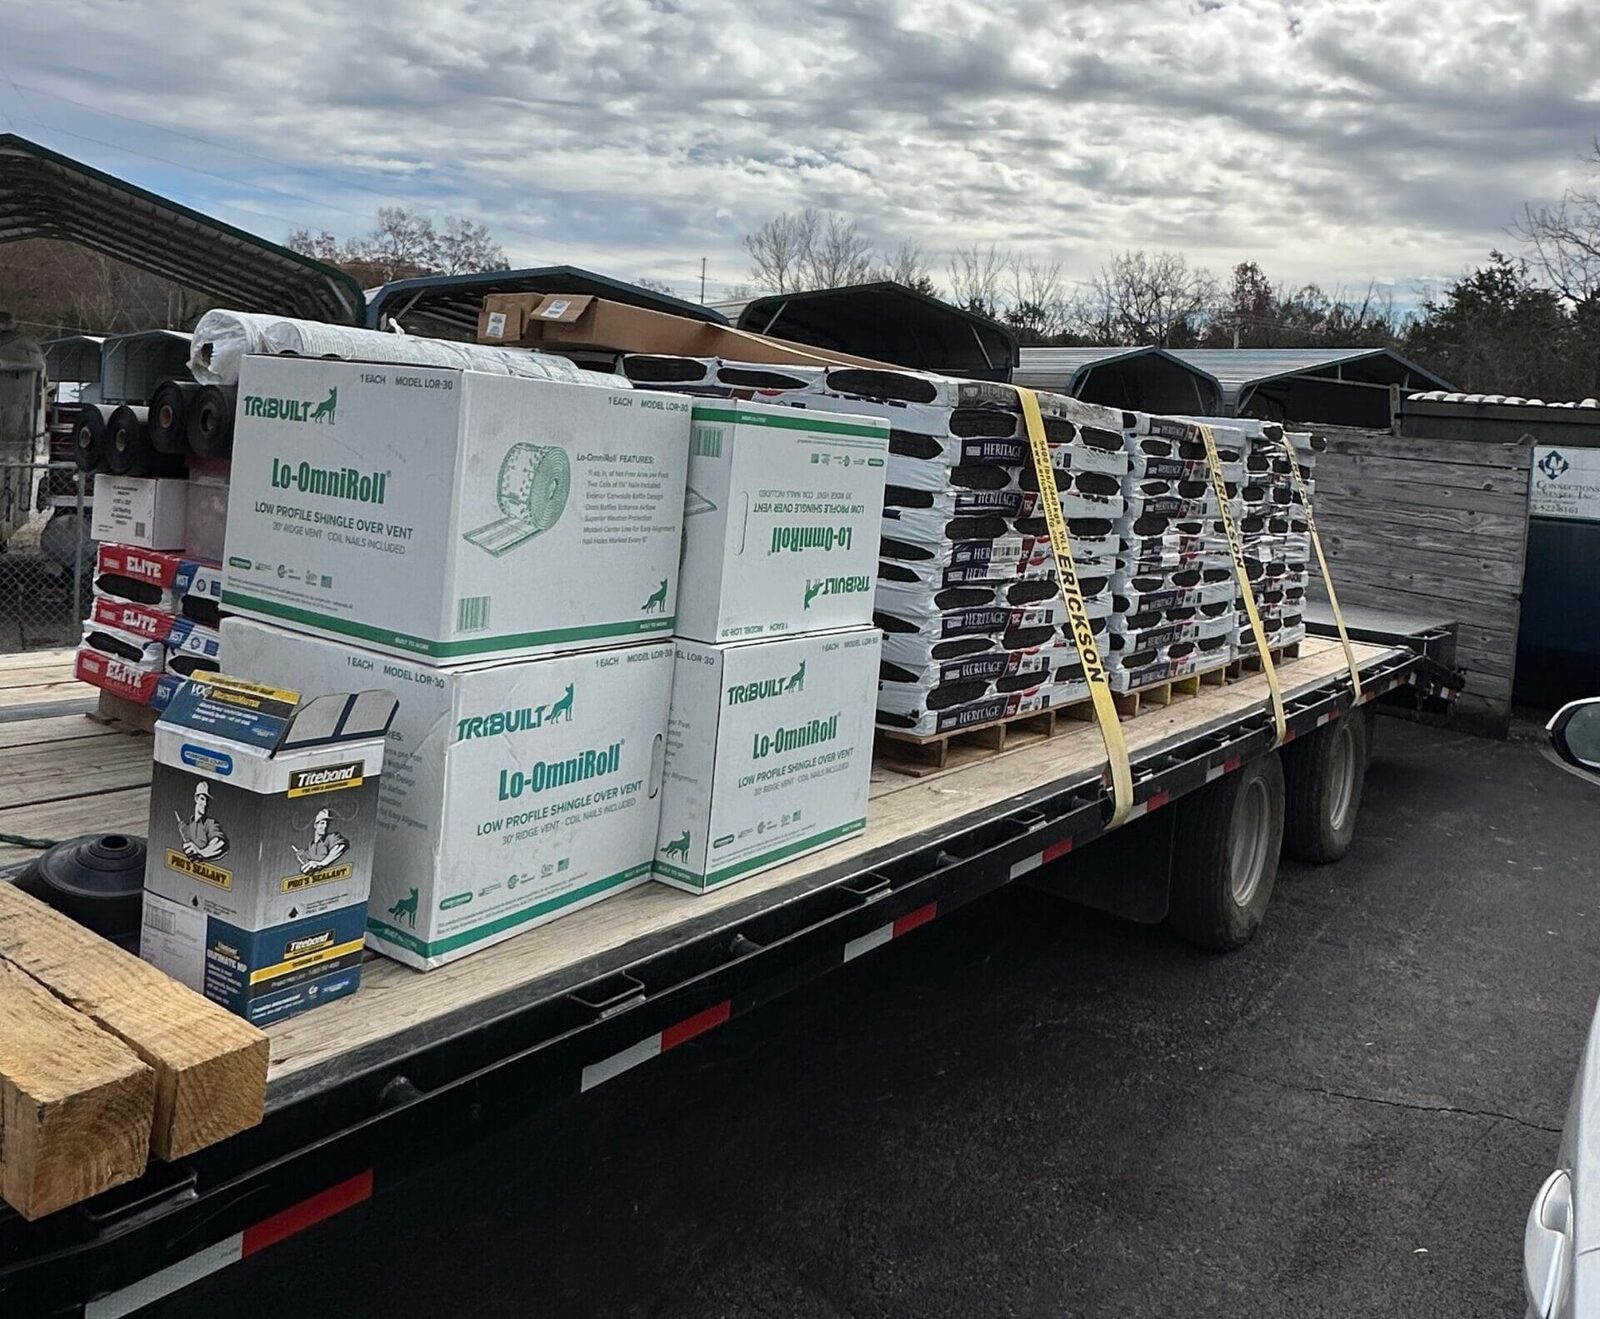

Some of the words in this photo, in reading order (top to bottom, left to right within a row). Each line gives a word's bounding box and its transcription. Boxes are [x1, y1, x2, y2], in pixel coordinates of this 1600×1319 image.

[366, 374, 386, 385] EACH
[395, 376, 424, 388] MODEL
[424, 378, 454, 390] LOR-30
[243, 395, 316, 422] TRIBUILT
[613, 397, 632, 407] EACH
[640, 400, 664, 411] MODEL
[666, 402, 689, 412] LOR-30
[619, 455, 655, 464] FEATURES:
[984, 443, 1023, 457] HERITAGE
[271, 458, 388, 505] Lo-OmniRoll
[753, 503, 772, 513] VENT
[774, 503, 793, 513] OVER
[794, 503, 822, 513] SHINGLE
[823, 504, 849, 514] PROFILE
[850, 504, 864, 514] LOW
[978, 493, 1017, 506] HERITAGE
[255, 501, 275, 515] LOW
[276, 505, 313, 522] PROFILE
[314, 512, 354, 530] SHINGLE
[356, 519, 384, 536] OVER
[386, 524, 414, 540] VENT
[1214, 472, 1244, 569] ERICKSON
[283, 523, 304, 536] RIDGE
[305, 527, 322, 538] VENT
[327, 531, 344, 544] COIL
[345, 534, 366, 548] NAILS
[368, 538, 406, 554] INCLUDED
[771, 527, 852, 553] Lo-OmniRoll
[127, 556, 162, 578] ELITE
[822, 576, 870, 595] TRIBUILT
[122, 609, 158, 632] ELITE
[744, 625, 763, 635] MODEL
[964, 612, 1006, 626] HERITAGE
[1058, 554, 1104, 684] ERICKSON
[600, 656, 620, 667] EACH
[627, 653, 650, 663] MODEL
[686, 652, 715, 666] LOR-30
[962, 662, 1001, 676] HERITAGE
[106, 660, 144, 688] ELITE
[347, 656, 351, 665] 1
[352, 657, 374, 671] EACH
[384, 665, 413, 681] MODEL
[415, 673, 445, 688] LOR-30
[727, 676, 789, 706] TRIBUILT
[456, 705, 549, 741] TRIBUILT
[959, 706, 1000, 724] HERITAGE
[752, 714, 838, 760] Lo-OmniRoll
[298, 765, 357, 787] Titebond
[499, 743, 621, 801] Lo-OmniRoll
[738, 775, 755, 789] LOW
[756, 766, 786, 782] PROFILE
[787, 757, 816, 774] SHINGLE
[817, 753, 836, 766] OVER
[836, 748, 854, 761] VENT
[780, 778, 796, 790] VENT
[797, 773, 810, 784] COIL
[477, 819, 504, 836] LOW
[506, 808, 549, 829] PROFILE
[550, 794, 592, 817] SHINGLE
[593, 788, 618, 804] OVER
[618, 780, 643, 798] VENT
[515, 827, 539, 842] RIDGE
[540, 820, 560, 834] VENT
[565, 814, 582, 827] COIL
[583, 807, 603, 821] NAILS
[603, 798, 636, 815] INCLUDED
[171, 855, 191, 871] PRO'S
[192, 860, 227, 885] SEALANT
[287, 876, 310, 890] PRO'S
[311, 868, 347, 884] SEALANT
